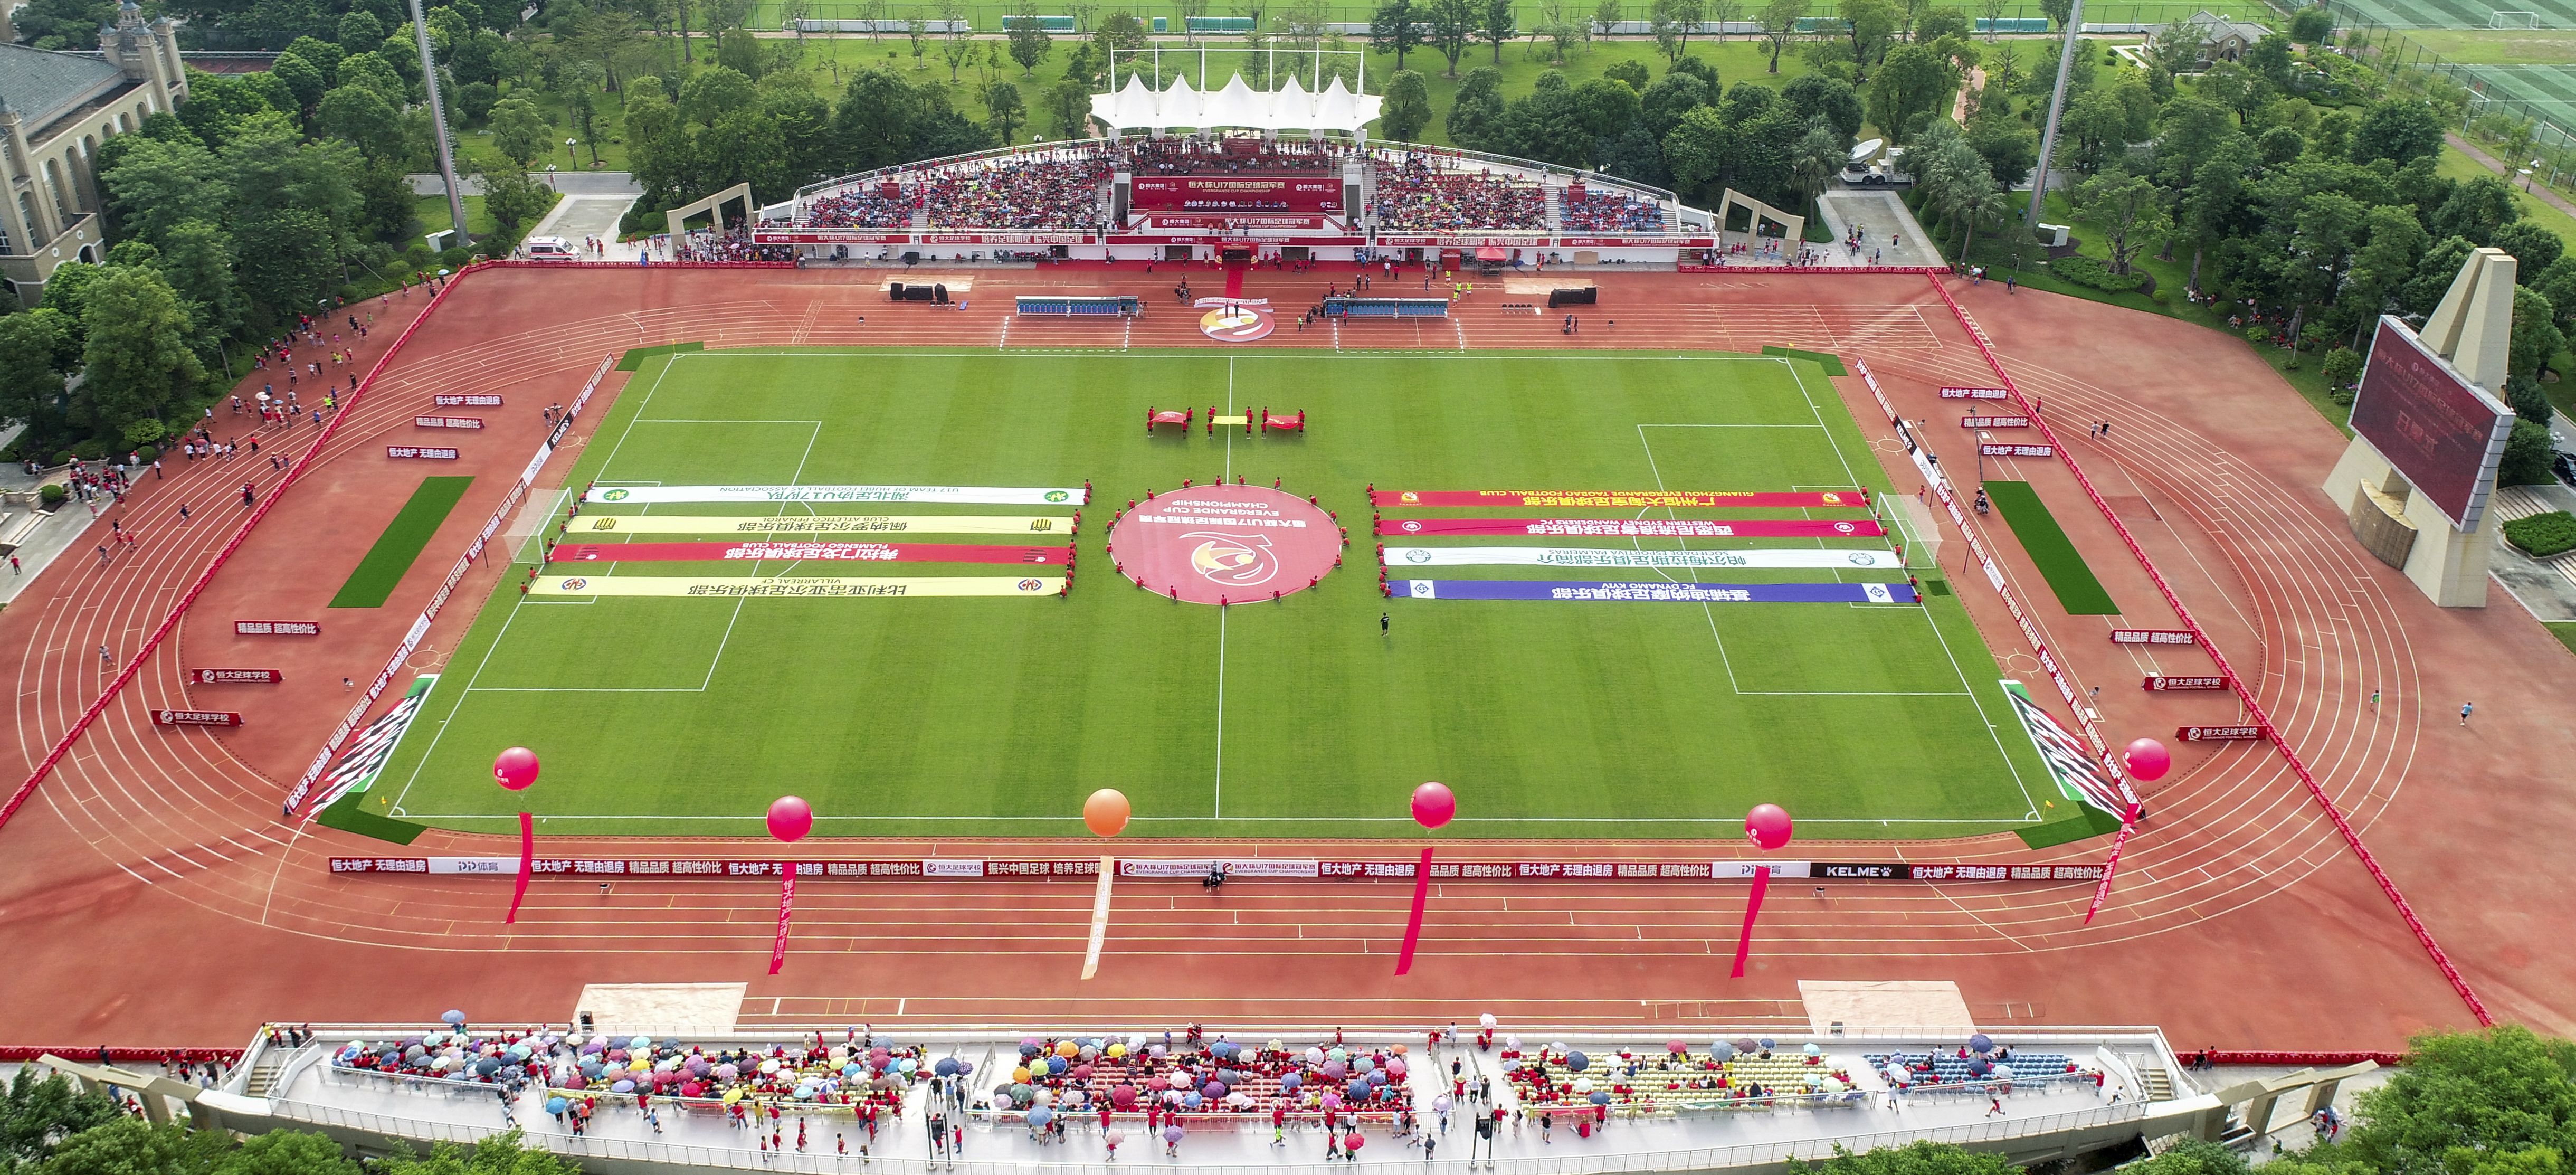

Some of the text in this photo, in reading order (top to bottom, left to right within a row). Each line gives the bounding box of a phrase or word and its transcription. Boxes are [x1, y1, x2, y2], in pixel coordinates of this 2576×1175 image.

[1942, 388, 2007, 399] 恒大地产 无理由退房
[436, 396, 500, 405] 恒大地产 无理由退房
[416, 417, 480, 428] 精品品质 超高性价比
[1964, 418, 2028, 427] 精品品质 超高性价比
[389, 448, 456, 459] 恒大地产 无理由退房
[1983, 446, 2051, 456] 恒大地产 无理由退房
[1172, 500, 1268, 508] CHAMPIONSHIP
[1523, 496, 1715, 506] 广州恒大淘宝足球俱乐部
[1193, 507, 1279, 516] EVERGRANDE
[1139, 515, 1306, 527] 恒大杯U17国际足球冠军赛
[1527, 524, 1734, 536] 西悉尼流浪者足球俱乐部
[724, 548, 899, 560] 弗拉门戈足球俱乐部
[1537, 554, 1746, 566] 帕尔梅拉斯足俱乐部简介
[688, 585, 907, 595] 比利亚雷亚尔足球俱乐部
[1552, 588, 1750, 601] 基辅迪纳摩足球俱乐部
[237, 623, 316, 634] 精品品质 超高性价比
[2115, 631, 2193, 644] 精品品质 超高性价比
[216, 671, 270, 679] 恒大足球学校
[175, 713, 229, 722] 恒大足球学校
[332, 860, 426, 872] 恒大地产 无理由退房
[531, 860, 722, 874] 恒大地产 无理由退房 精品品质 超高性价比
[728, 863, 769, 875] 恒大地产
[828, 863, 867, 875] 精品品质
[870, 863, 920, 875] 超高性价比
[988, 863, 1050, 875] 振兴中国足球
[1322, 863, 1512, 877] 恒大地产 无理由退房 品品质 超高性价比
[1519, 864, 1709, 877] 恒大地产 无理由退房 精品品质 超高性价比
[1826, 867, 1879, 876] KELME
[1913, 867, 2103, 879] 恒大地产 无理由退房 精品品质 超高性价比
[781, 878, 794, 918] 恒大地产
